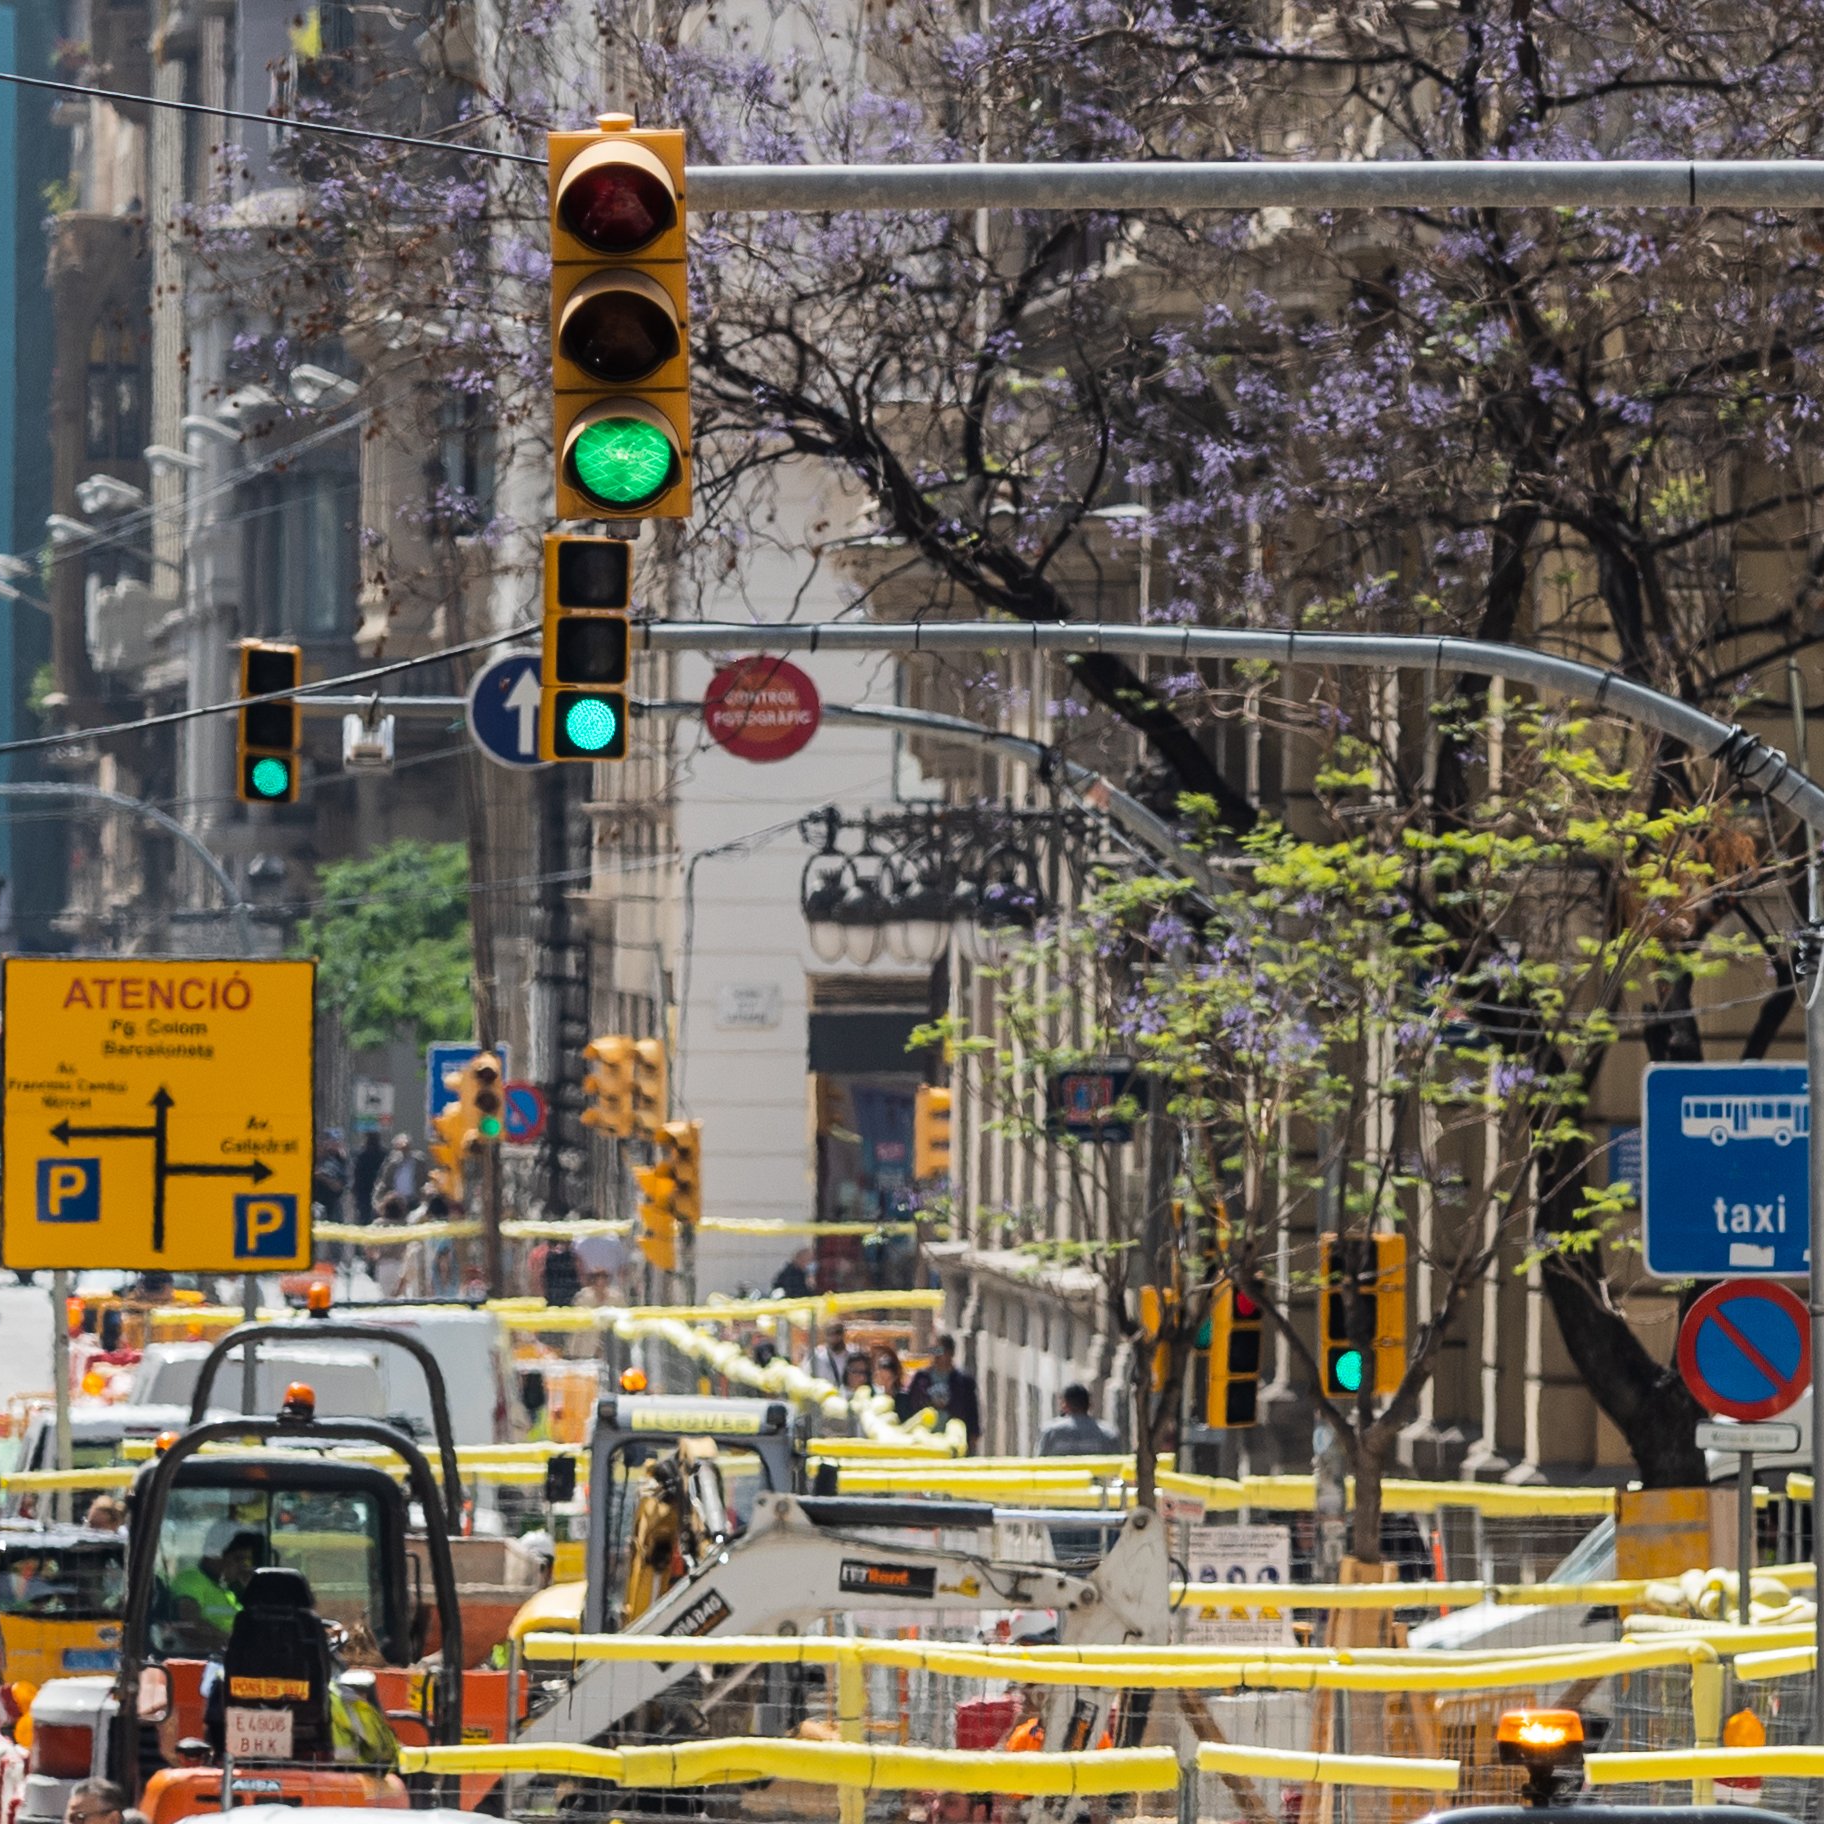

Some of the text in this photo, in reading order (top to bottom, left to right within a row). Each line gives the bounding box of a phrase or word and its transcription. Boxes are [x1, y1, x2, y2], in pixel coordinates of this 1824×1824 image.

[725, 689, 796, 706] CONTROL
[63, 970, 252, 1011] ATENCIÓ
[48, 1166, 87, 1216] P
[246, 1202, 285, 1252] P
[1714, 1196, 1787, 1234] taxi
